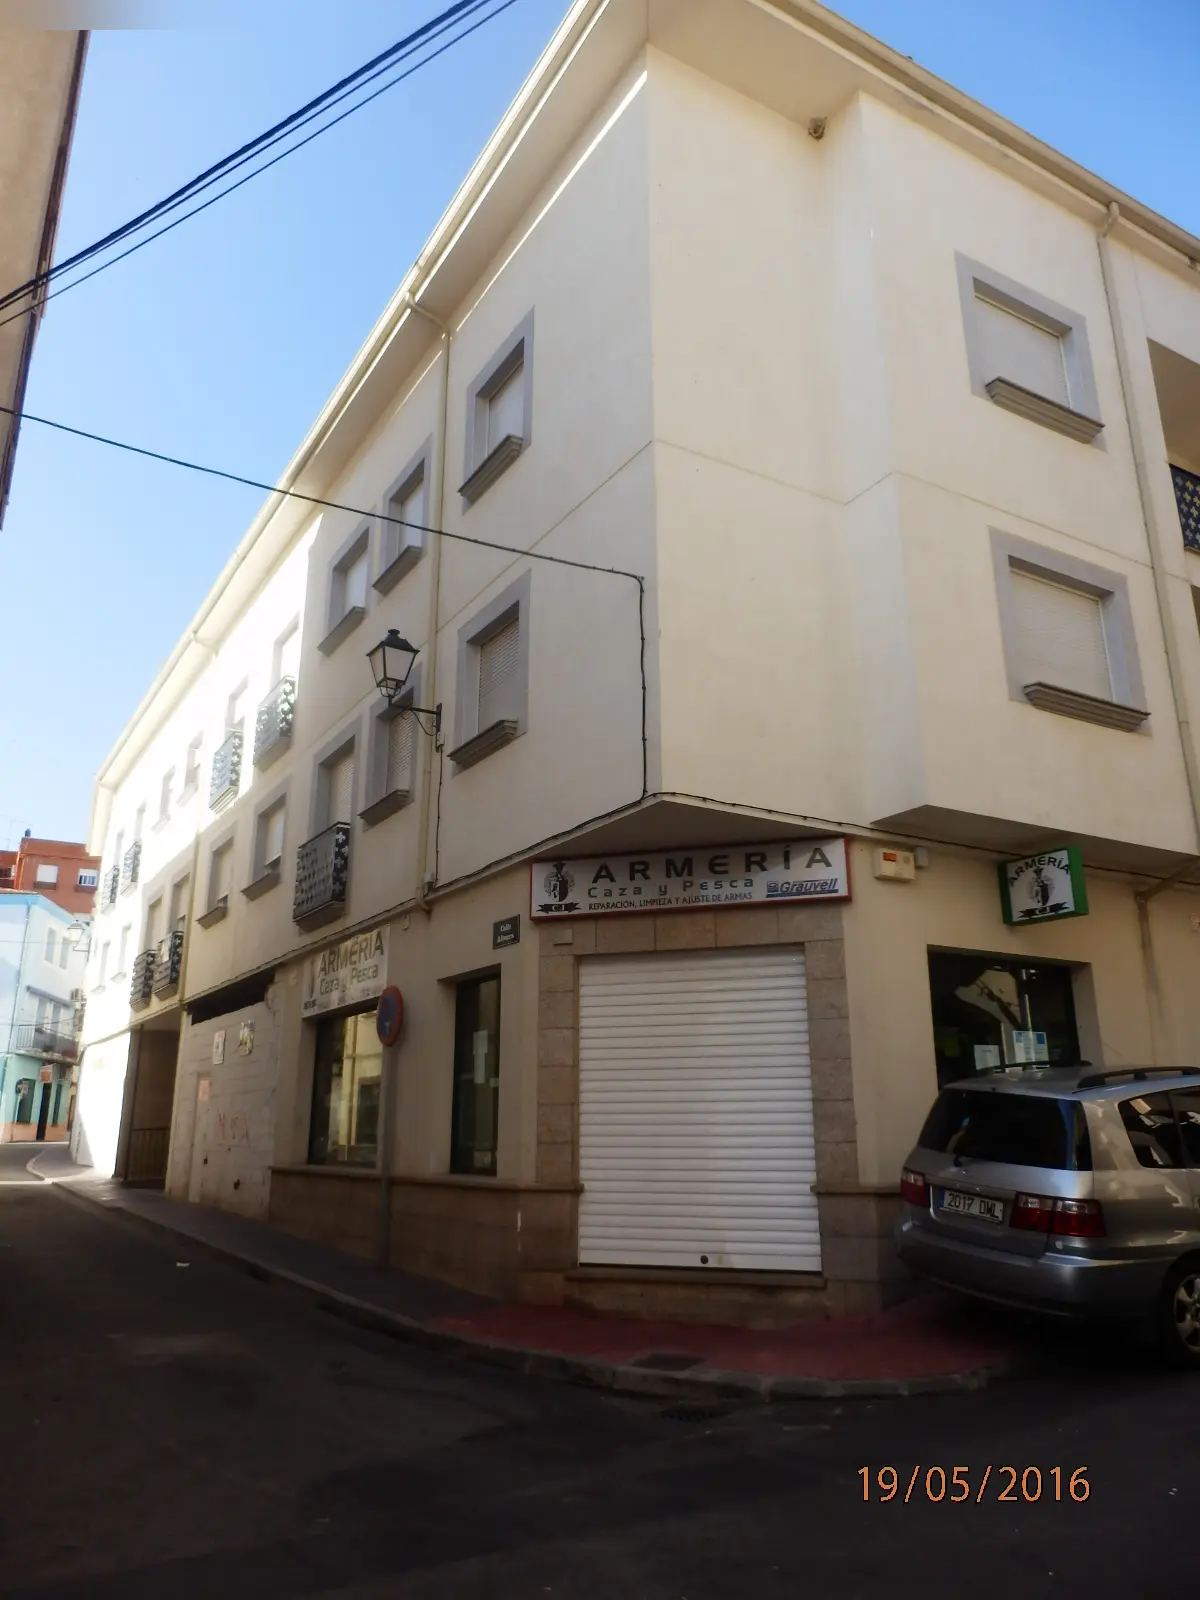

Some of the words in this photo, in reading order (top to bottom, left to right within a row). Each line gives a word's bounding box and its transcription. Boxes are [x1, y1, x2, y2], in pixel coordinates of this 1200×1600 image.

[591, 844, 833, 884] ARMERÍA
[1009, 855, 1070, 887] ARMERÍA
[588, 885, 642, 898] Caza
[658, 884, 668, 896] y
[682, 878, 754, 892] Pesca
[779, 877, 838, 894] Grauvell
[639, 897, 673, 908] LIMPIEZA
[674, 896, 681, 905] Y
[681, 894, 711, 905] AJUSTE
[712, 893, 721, 902] DE
[723, 891, 753, 902] ARMAS
[319, 977, 340, 995] Caza
[350, 964, 379, 985] Pesca
[947, 1192, 975, 1211] 2017
